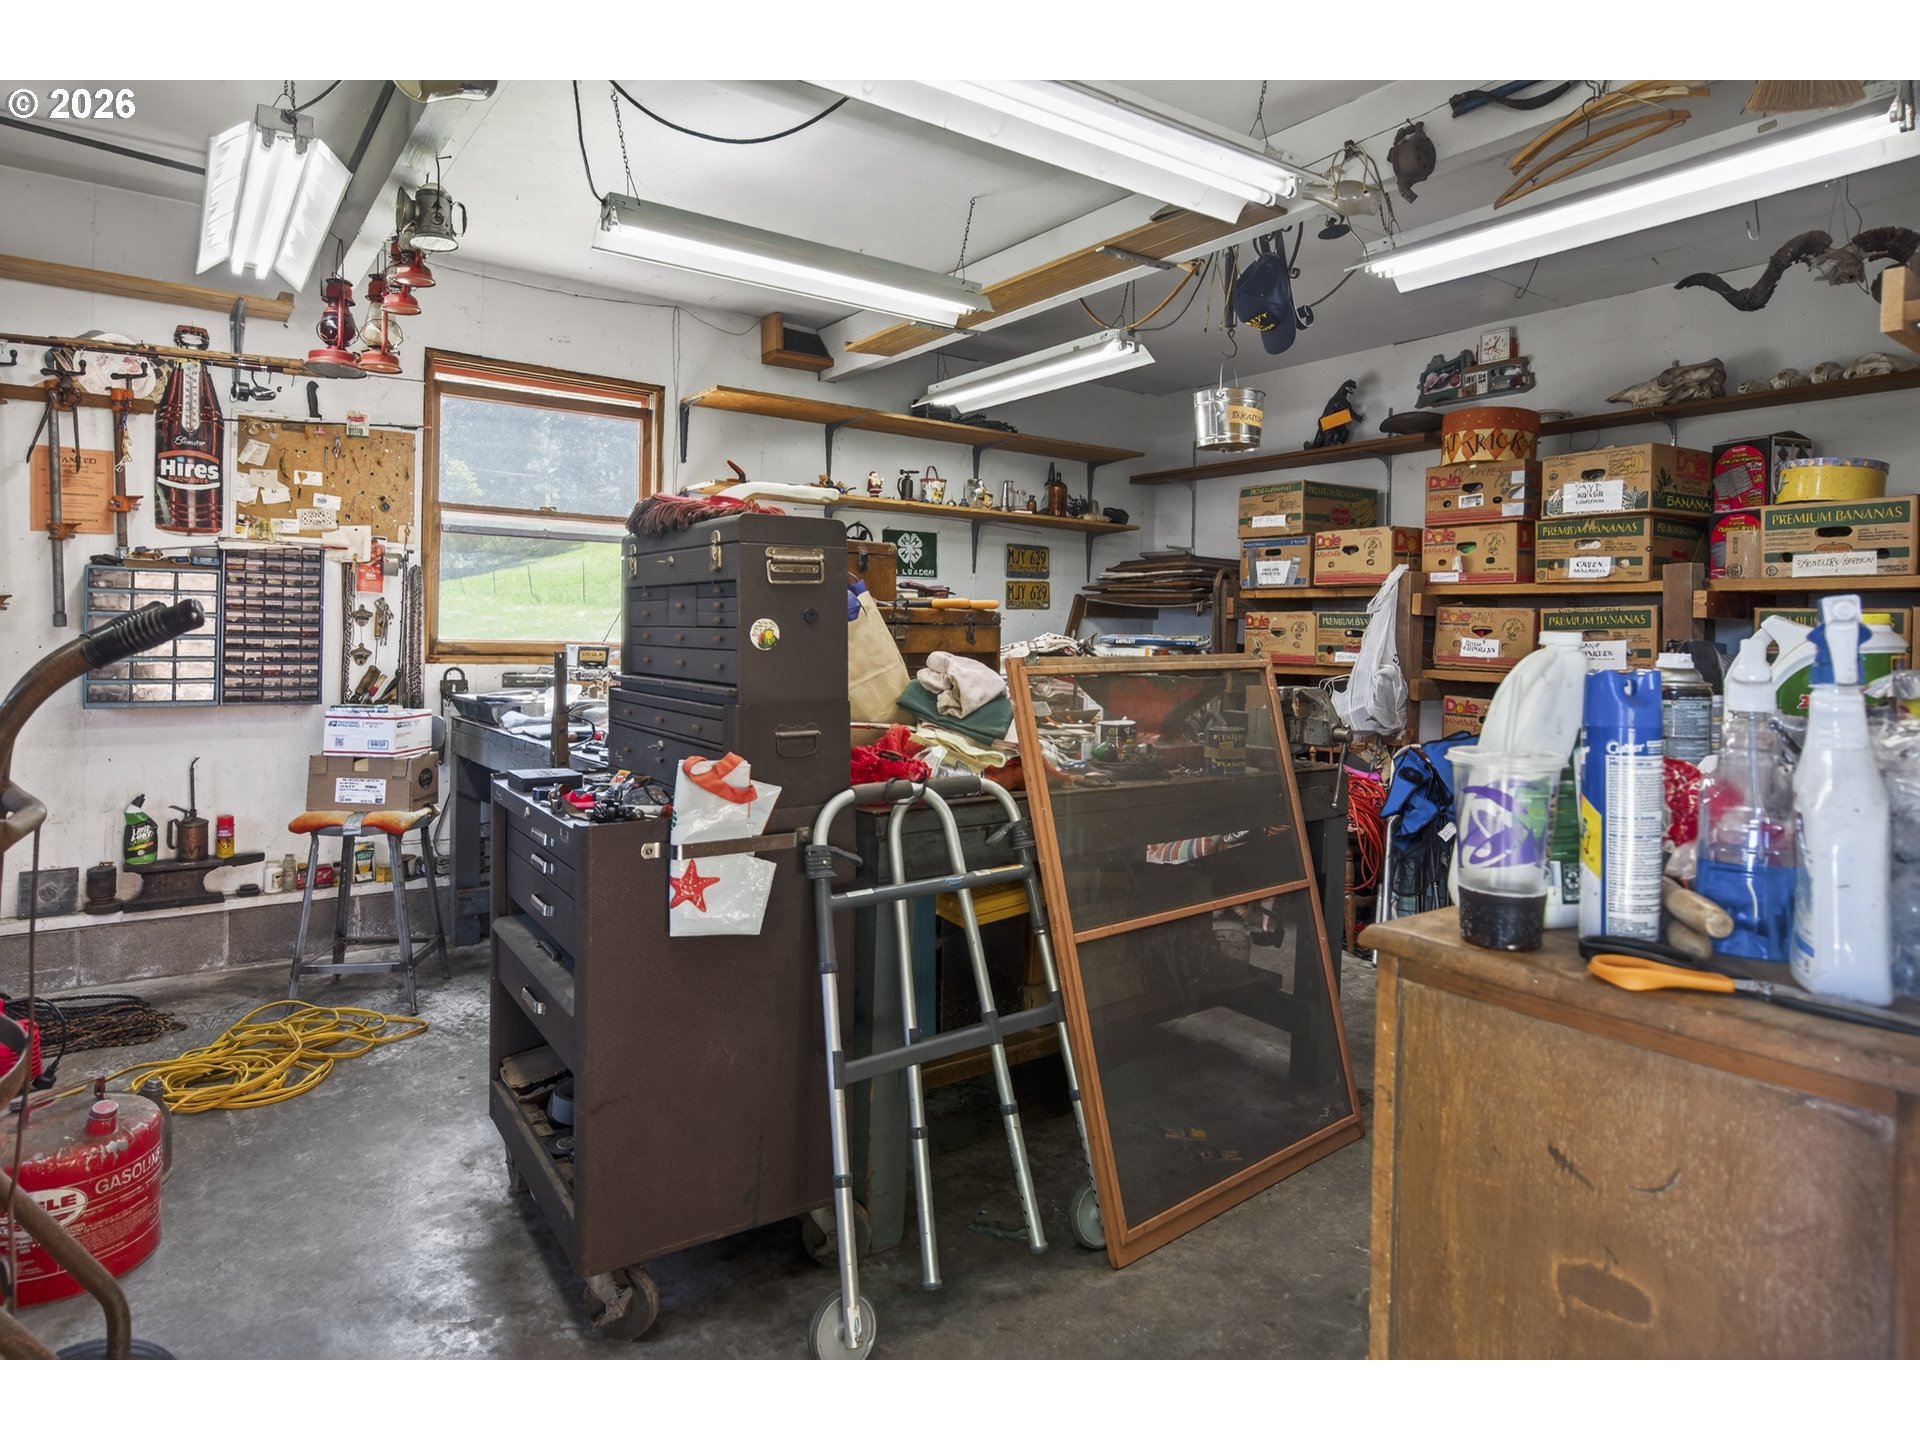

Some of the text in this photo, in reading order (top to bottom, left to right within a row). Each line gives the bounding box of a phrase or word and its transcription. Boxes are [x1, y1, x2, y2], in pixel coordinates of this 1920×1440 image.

[160, 456, 219, 480] Hires
[1428, 473, 1462, 488] Dole
[1666, 497, 1712, 511] BANANA
[1772, 505, 1903, 526] PREMIUM BANANAS
[1316, 532, 1342, 547] Dole
[1424, 528, 1457, 543] Dole
[1245, 614, 1270, 627] Dole
[1440, 609, 1470, 621] Dole
[1548, 614, 1646, 627] PREMIUM BANANAS
[1445, 698, 1479, 714] Dole
